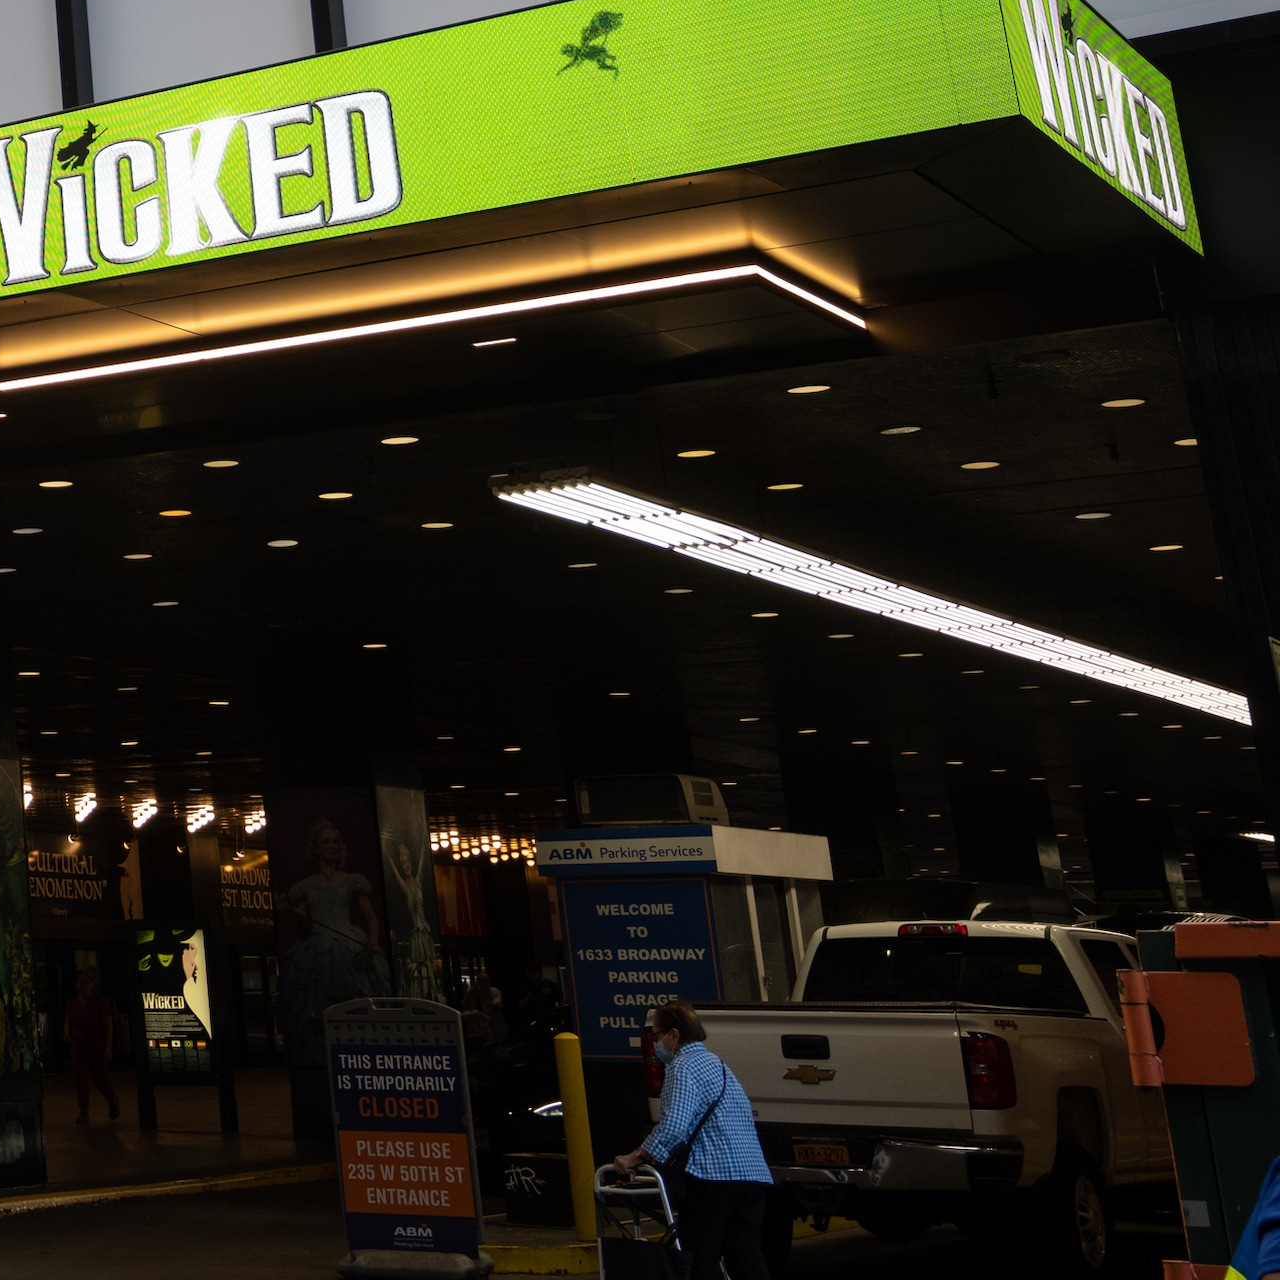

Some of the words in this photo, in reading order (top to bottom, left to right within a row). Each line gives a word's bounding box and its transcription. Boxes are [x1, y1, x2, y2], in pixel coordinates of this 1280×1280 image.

[549, 845, 592, 860] ABM
[600, 847, 646, 861] Parking
[649, 845, 703, 858] Services
[28, 850, 97, 875] CULTURAL
[595, 903, 674, 916] WELCOME
[626, 926, 649, 938] TO
[576, 948, 614, 961] 1633
[617, 948, 706, 961] BROADWAY
[608, 971, 679, 984] PARKING
[598, 1016, 640, 1029] PULL
[338, 1054, 371, 1070] THIS
[376, 1054, 452, 1071] ENTRANCE
[337, 1074, 352, 1090] IS
[355, 1075, 456, 1092] TEMPORARILY
[358, 1096, 440, 1119] CLOSED
[356, 1140, 415, 1158] PLEASE
[420, 1142, 452, 1159] USE
[347, 1163, 376, 1180] 235
[379, 1164, 395, 1181] W
[400, 1165, 440, 1183] 50TH
[445, 1167, 464, 1184] ST
[366, 1188, 451, 1207] ENTRANCE
[393, 1225, 433, 1238] ABM
